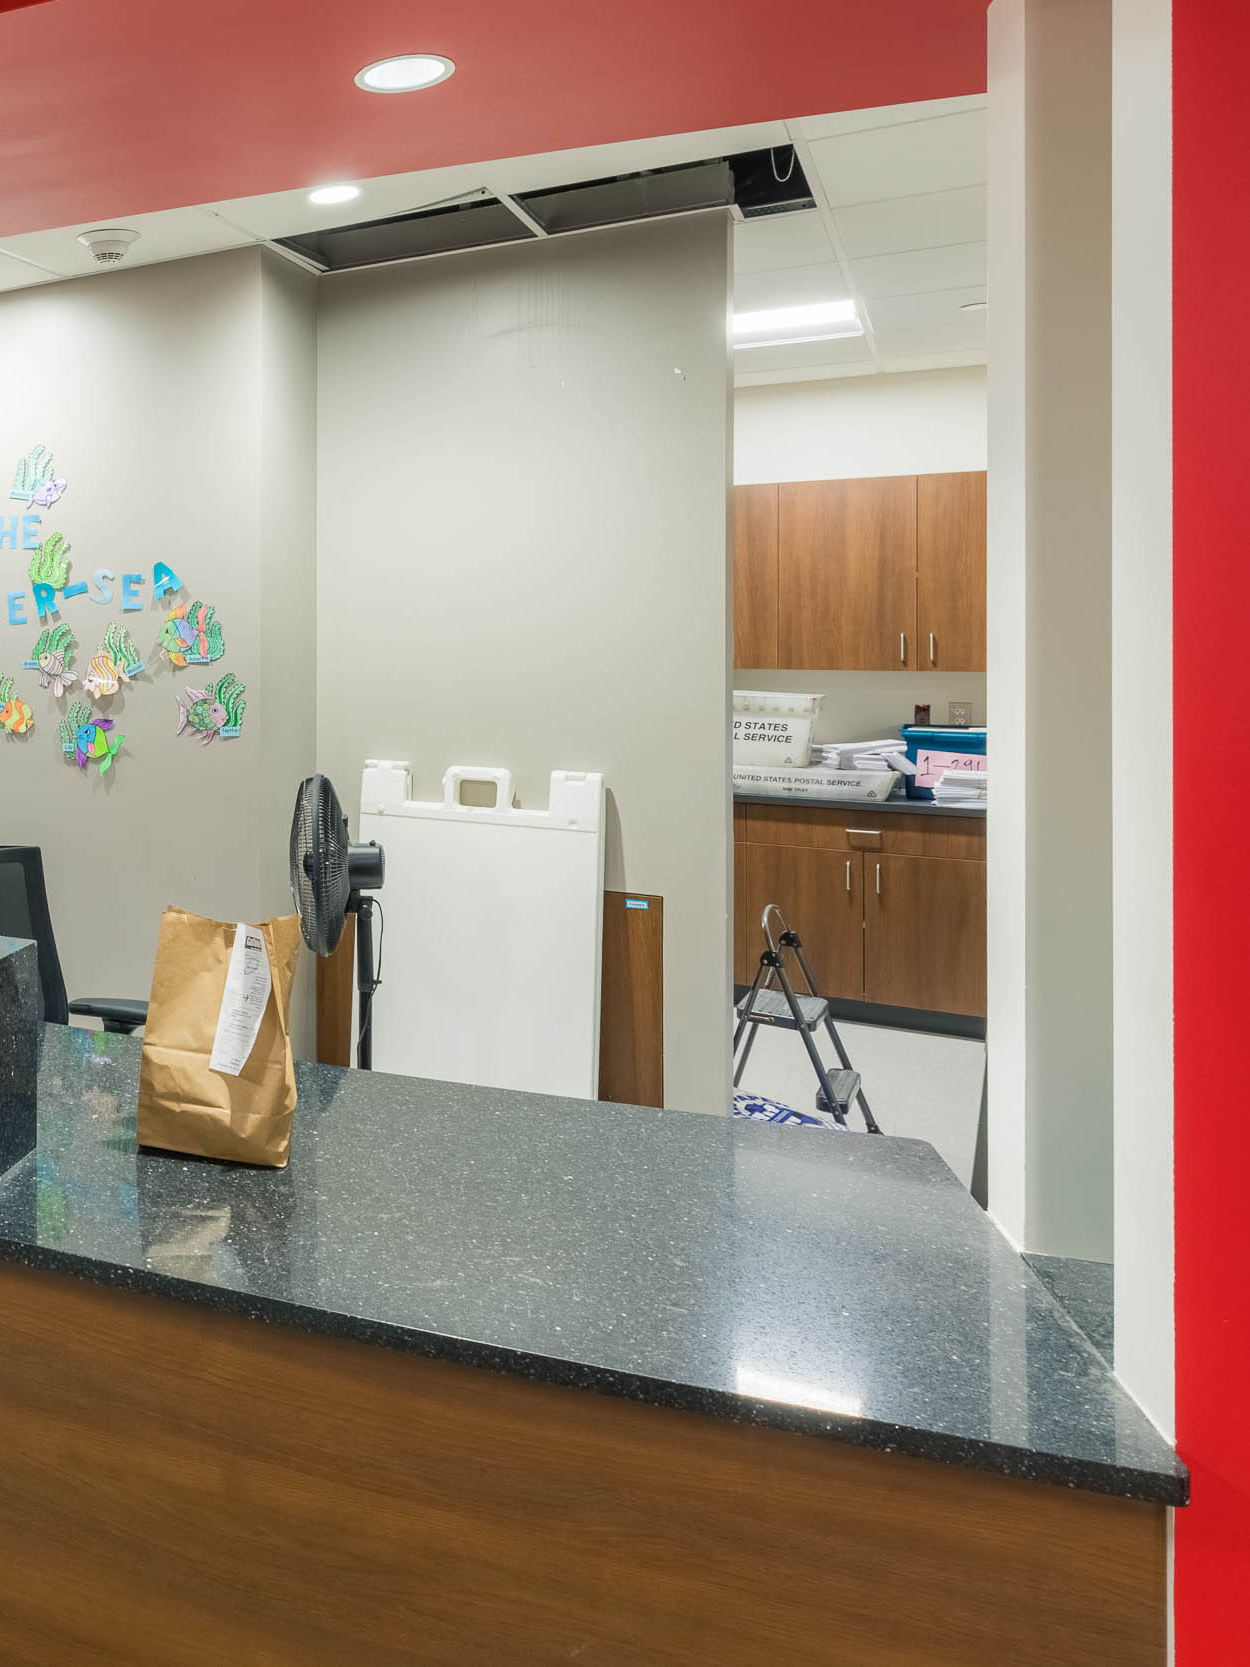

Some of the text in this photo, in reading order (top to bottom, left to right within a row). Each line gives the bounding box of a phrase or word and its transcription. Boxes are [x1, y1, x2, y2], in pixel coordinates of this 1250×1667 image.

[744, 721, 789, 732] STATES
[743, 732, 793, 744] SERVICE
[733, 773, 862, 787] UNITED STATES POSTAL SERVICE
